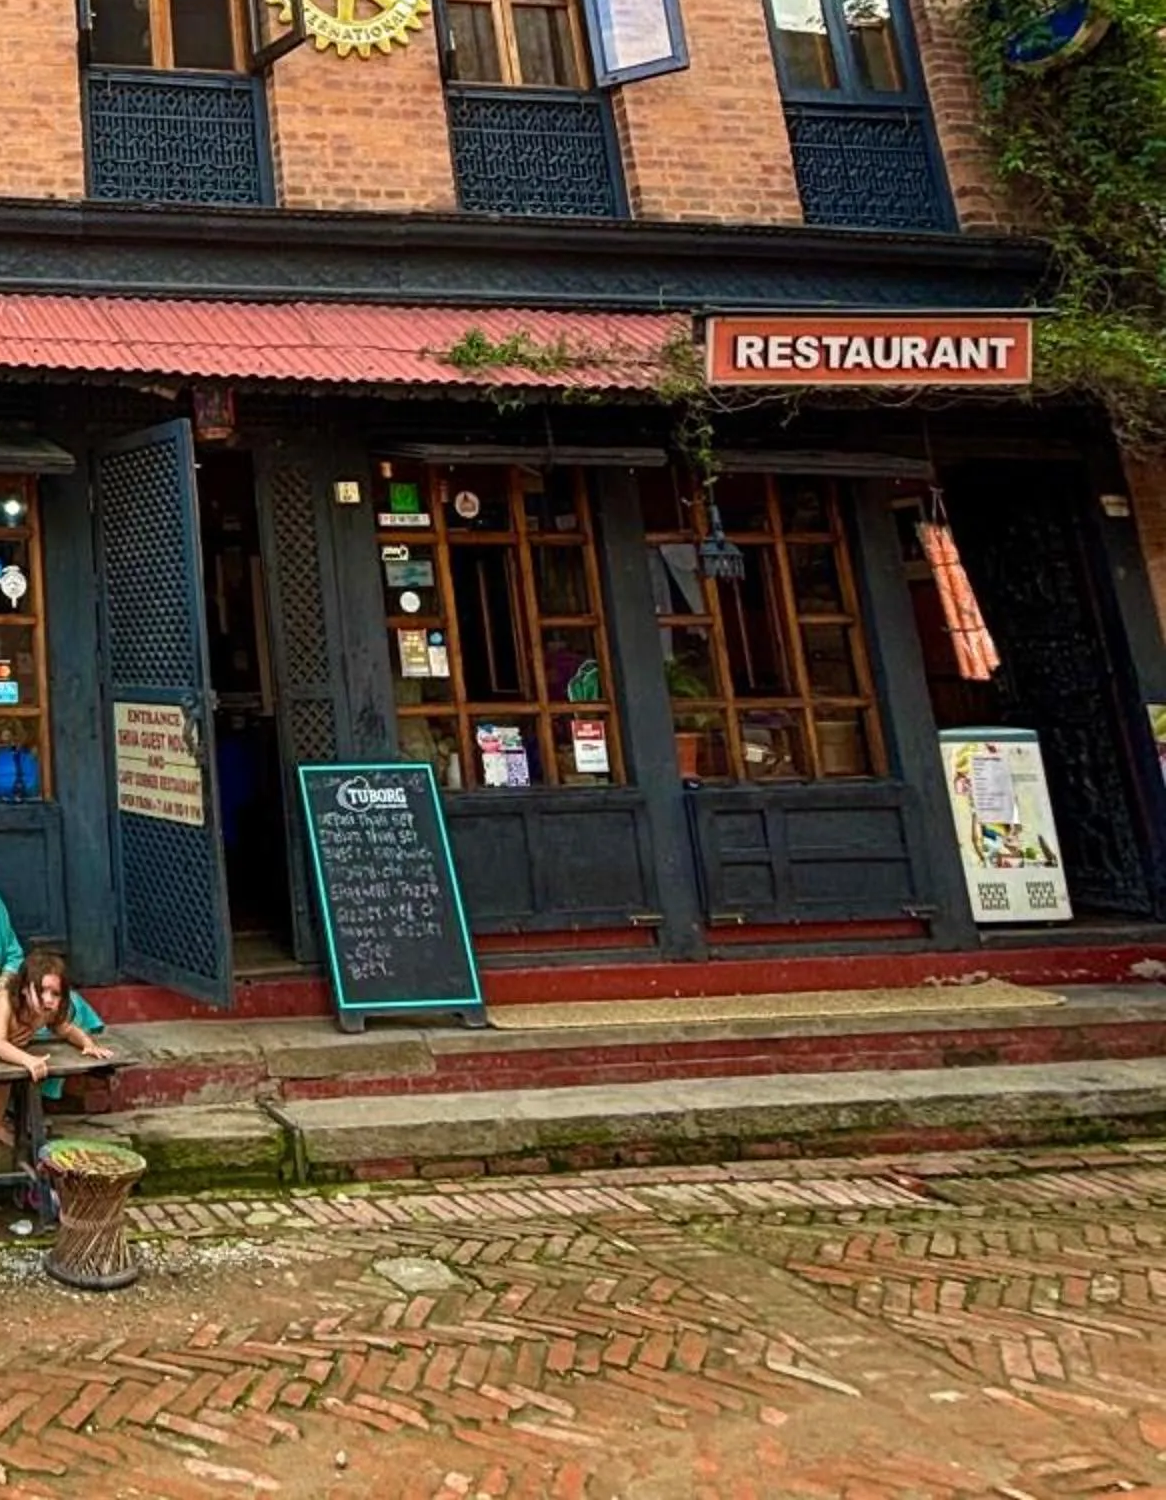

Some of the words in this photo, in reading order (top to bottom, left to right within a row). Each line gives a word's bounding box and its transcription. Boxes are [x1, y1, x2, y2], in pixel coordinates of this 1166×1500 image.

[736, 336, 1015, 370] RESTAURANT
[127, 708, 181, 727] ENTRANCE
[140, 731, 165, 750] GUEST
[346, 787, 407, 805] TUBORG
